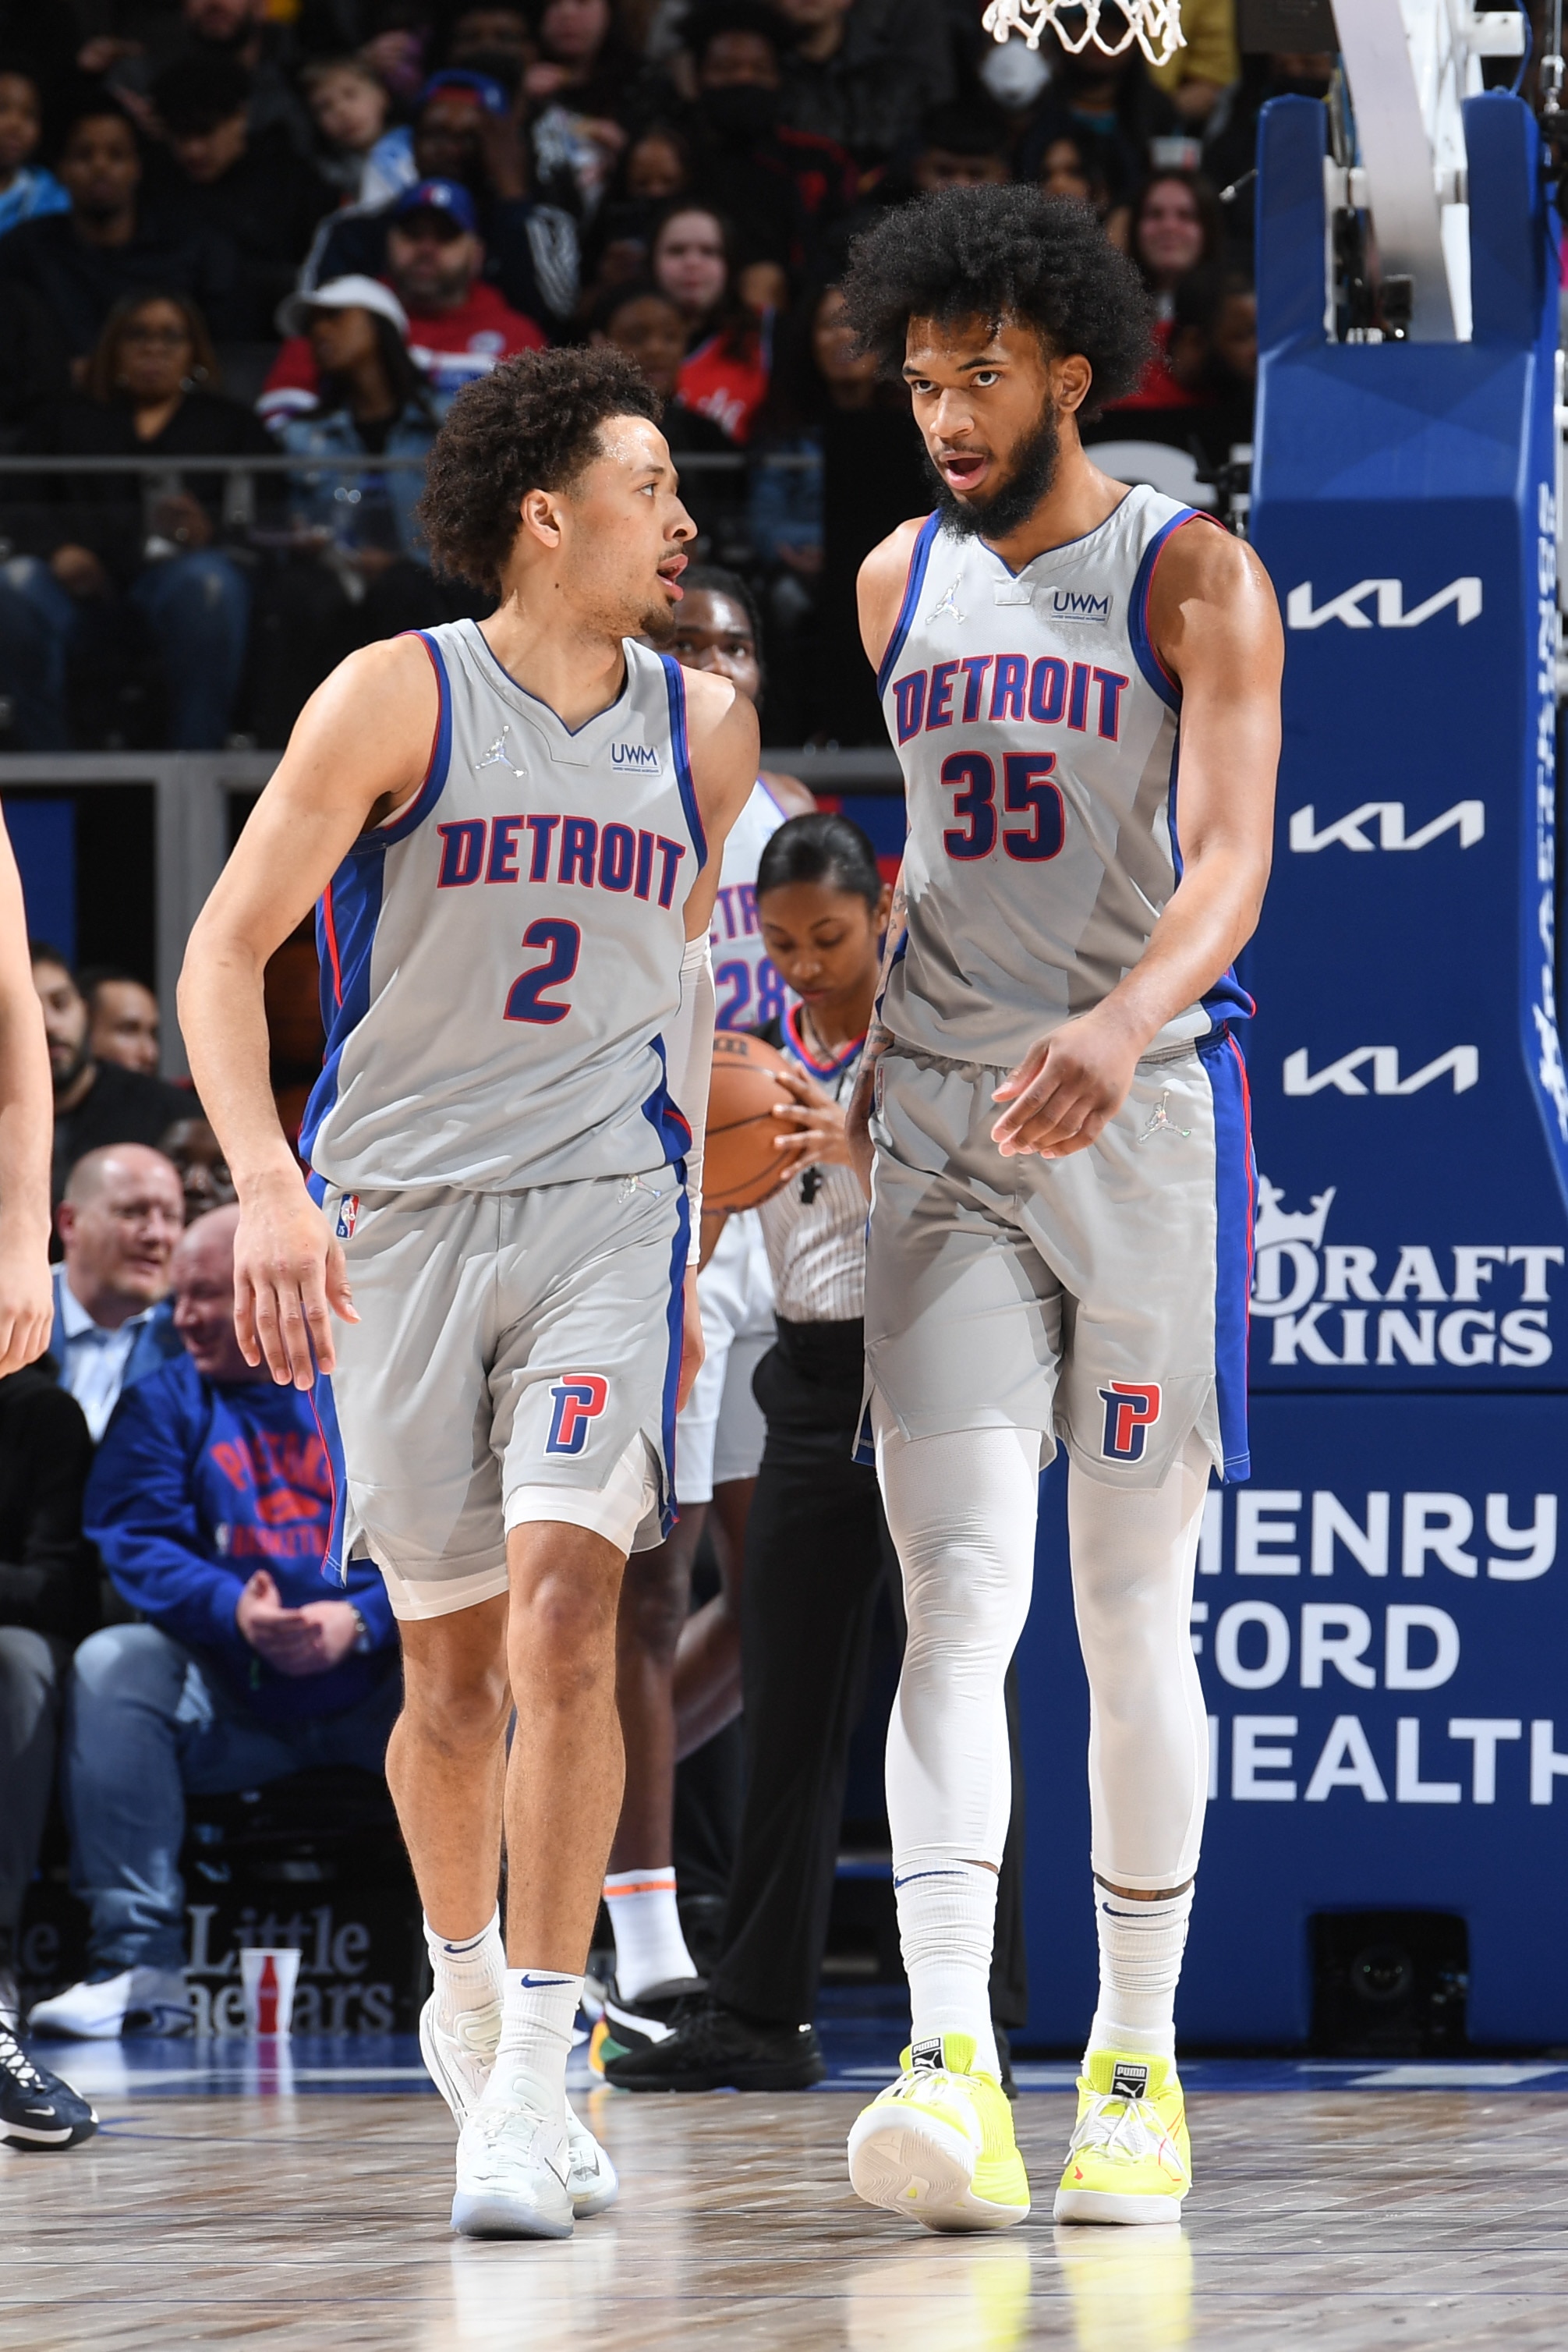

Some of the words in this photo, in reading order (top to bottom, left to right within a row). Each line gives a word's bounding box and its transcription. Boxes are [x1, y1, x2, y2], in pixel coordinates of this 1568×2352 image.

[1053, 591, 1109, 615] UWM
[893, 653, 1130, 747] DETROIT
[611, 742, 657, 766] UWM
[940, 750, 1066, 863] 35
[437, 814, 686, 911] DETROIT
[503, 917, 581, 1025] 2
[716, 956, 786, 1032] 28
[1249, 1239, 1565, 1318] DRAFT
[1269, 1302, 1553, 1368] KINGS
[1205, 1715, 1568, 1805] EALT
[1117, 2066, 1146, 2077] PUMA
